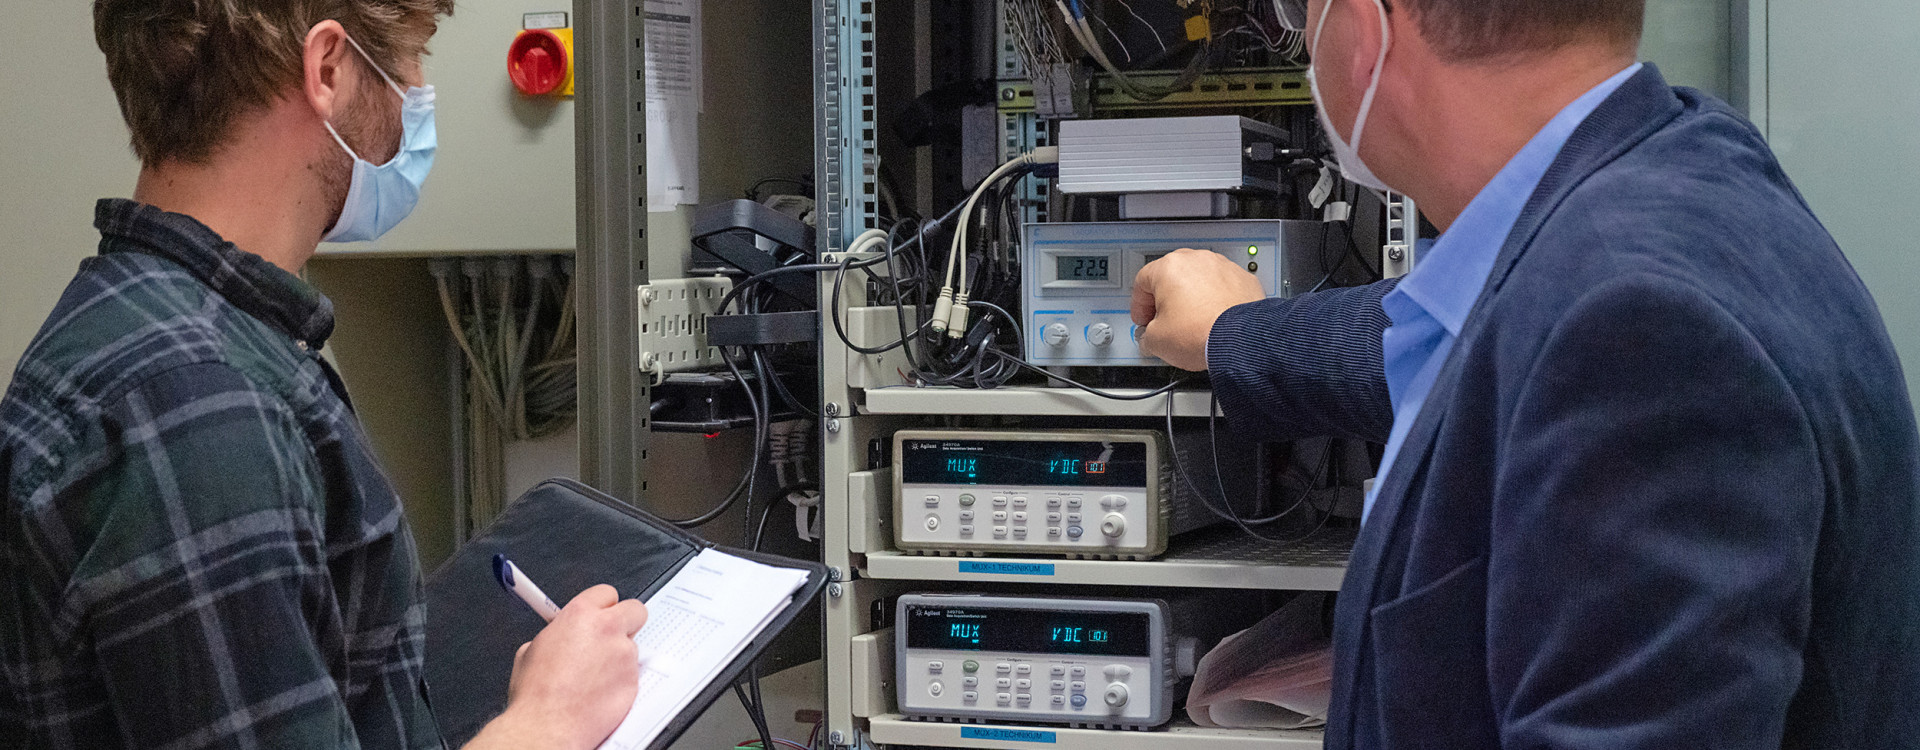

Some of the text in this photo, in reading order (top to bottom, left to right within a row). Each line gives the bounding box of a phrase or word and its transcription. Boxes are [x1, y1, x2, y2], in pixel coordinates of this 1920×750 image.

[1074, 259, 1108, 277] 22.9
[947, 458, 977, 473] MUX
[972, 563, 1040, 572] MUX-1 TECHNIKUM
[950, 623, 980, 638] MUX
[974, 729, 1042, 739] MUX-2 TECHNIKUM
